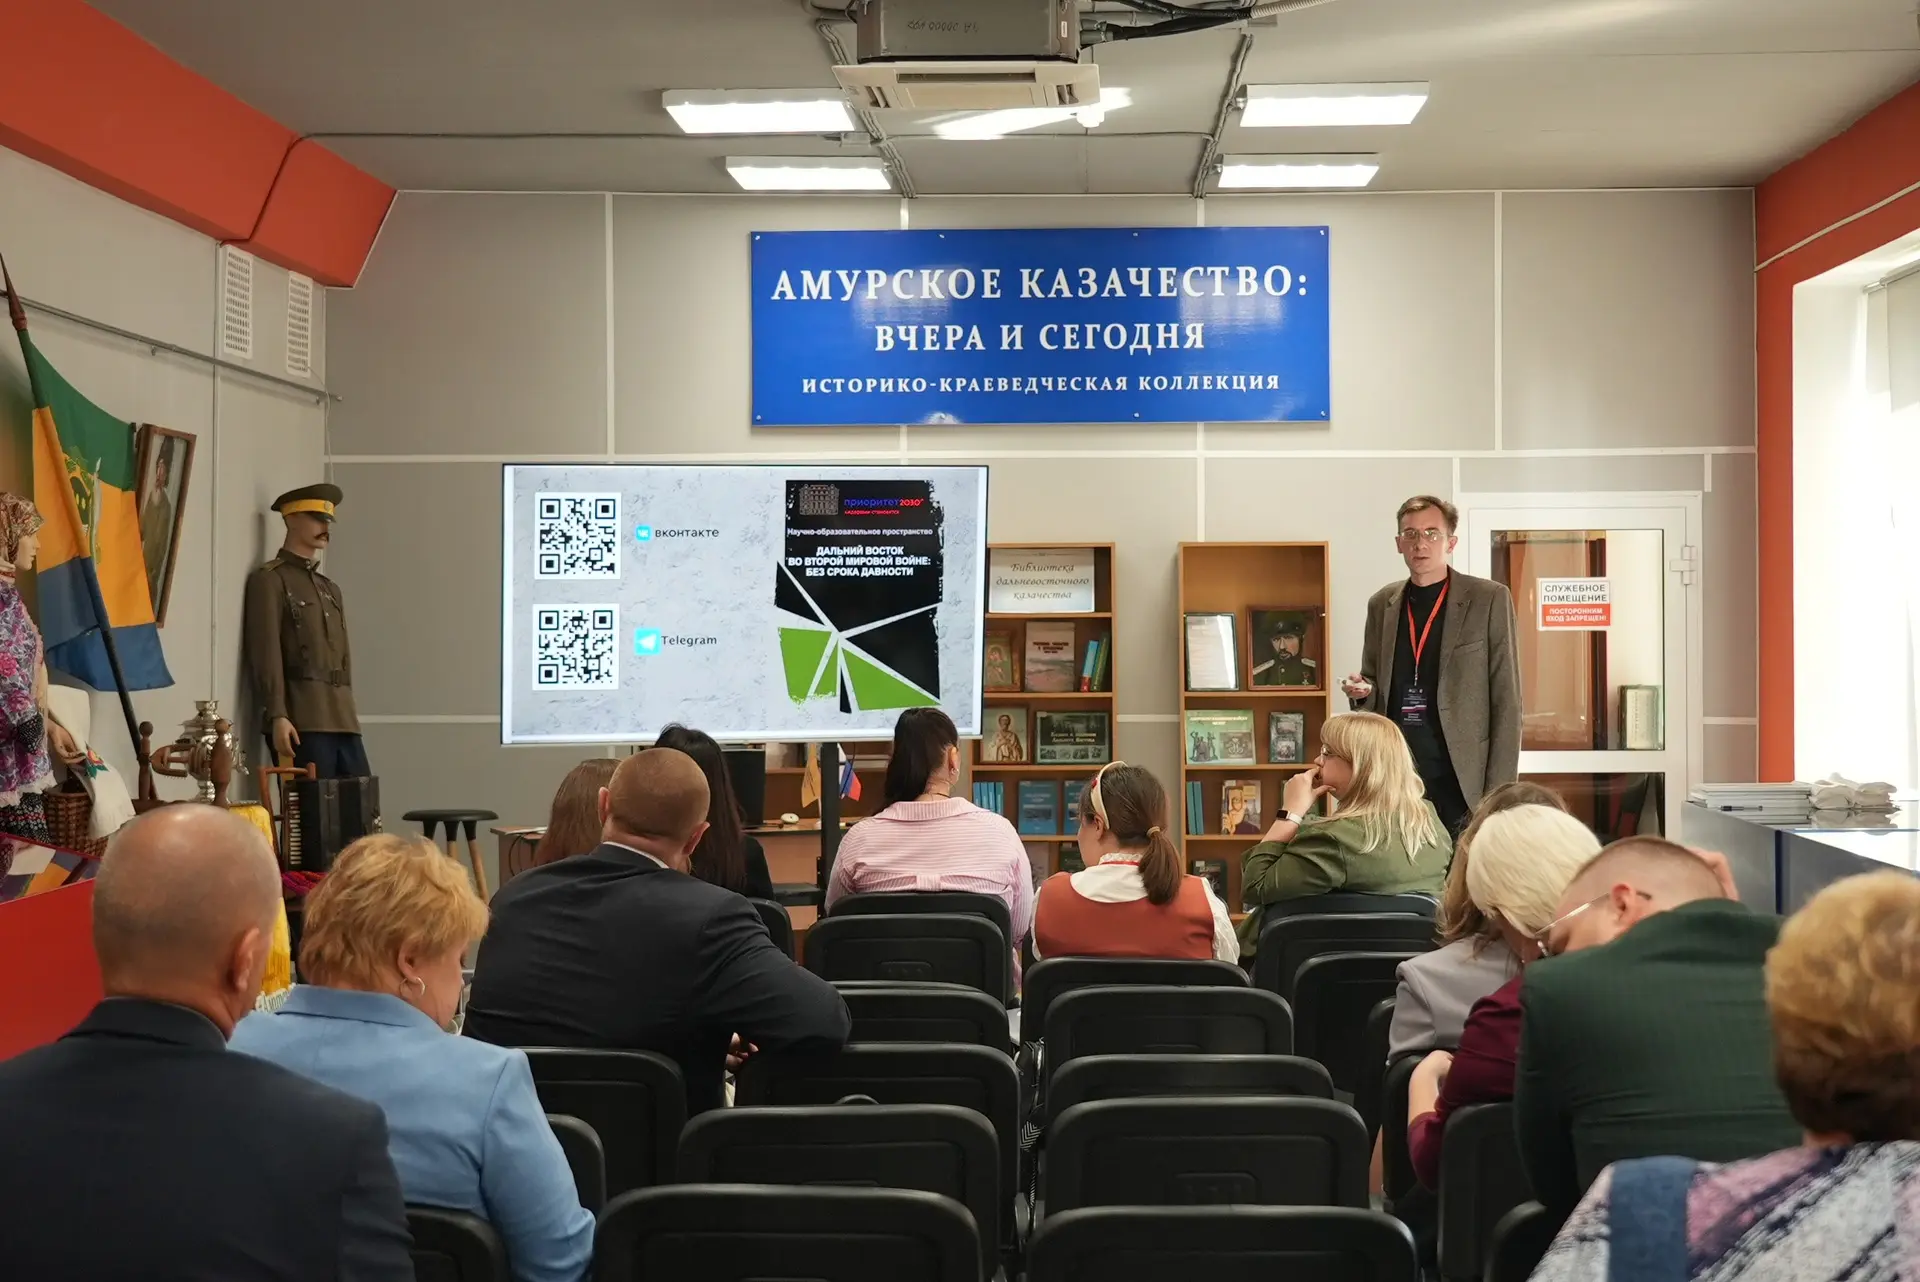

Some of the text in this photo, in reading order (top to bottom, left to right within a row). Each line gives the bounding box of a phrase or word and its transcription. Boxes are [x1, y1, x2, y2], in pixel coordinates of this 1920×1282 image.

[771, 265, 1308, 300] АМУРСКОЕ КАЗАЧЕСТВО:
[875, 323, 1205, 355] ВЧЕРА И СЕГОДНЯ
[802, 375, 1280, 395] ИСТОРИКО-КРАЕВЕДЧЕСКАЯ КОЛЛЕКЦИЯ
[655, 529, 720, 538] вконтакте
[787, 527, 934, 537] Научно-образовательное пространство
[816, 545, 904, 556] ДАЛЬНИЙ ВОСТОК
[787, 555, 932, 567] ВО ВТОРОЙ МИРОВОЙ ВОЙНЕ:
[805, 567, 914, 578] БЕЗ СРОКА ДАВНОСТИ
[1011, 562, 1075, 573] Библиотека
[995, 576, 1090, 586] дальневосточного
[1544, 584, 1606, 593] СЛУЖЕБНОЕ
[1013, 591, 1073, 602] казачества
[1543, 594, 1607, 603] ПОМЕЩЕНИЕ
[1549, 607, 1603, 615] ПОСТОРОННИМ
[661, 635, 718, 647] Telegram
